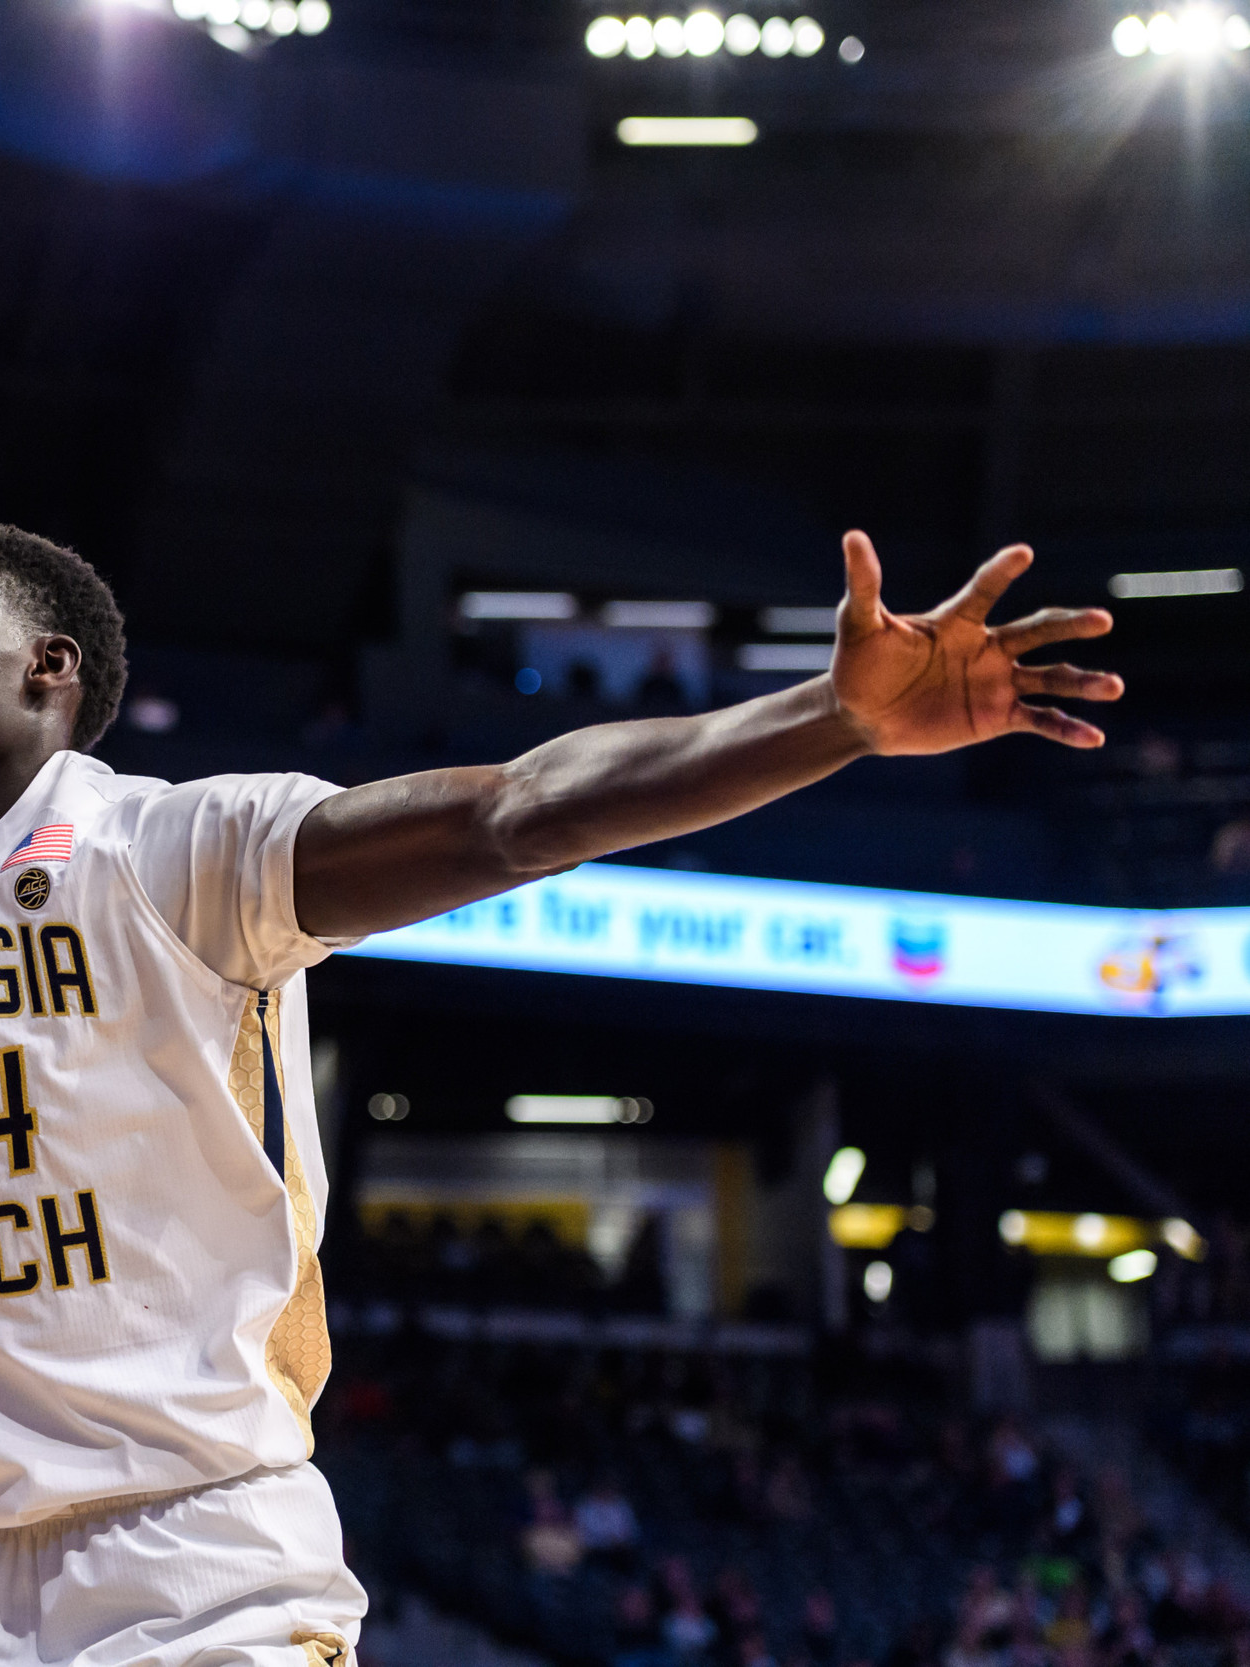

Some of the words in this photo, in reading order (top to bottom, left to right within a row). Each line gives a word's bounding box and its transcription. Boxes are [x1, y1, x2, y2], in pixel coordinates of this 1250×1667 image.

[20, 879, 47, 895] ACC
[542, 884, 610, 938] for
[634, 904, 740, 968] your
